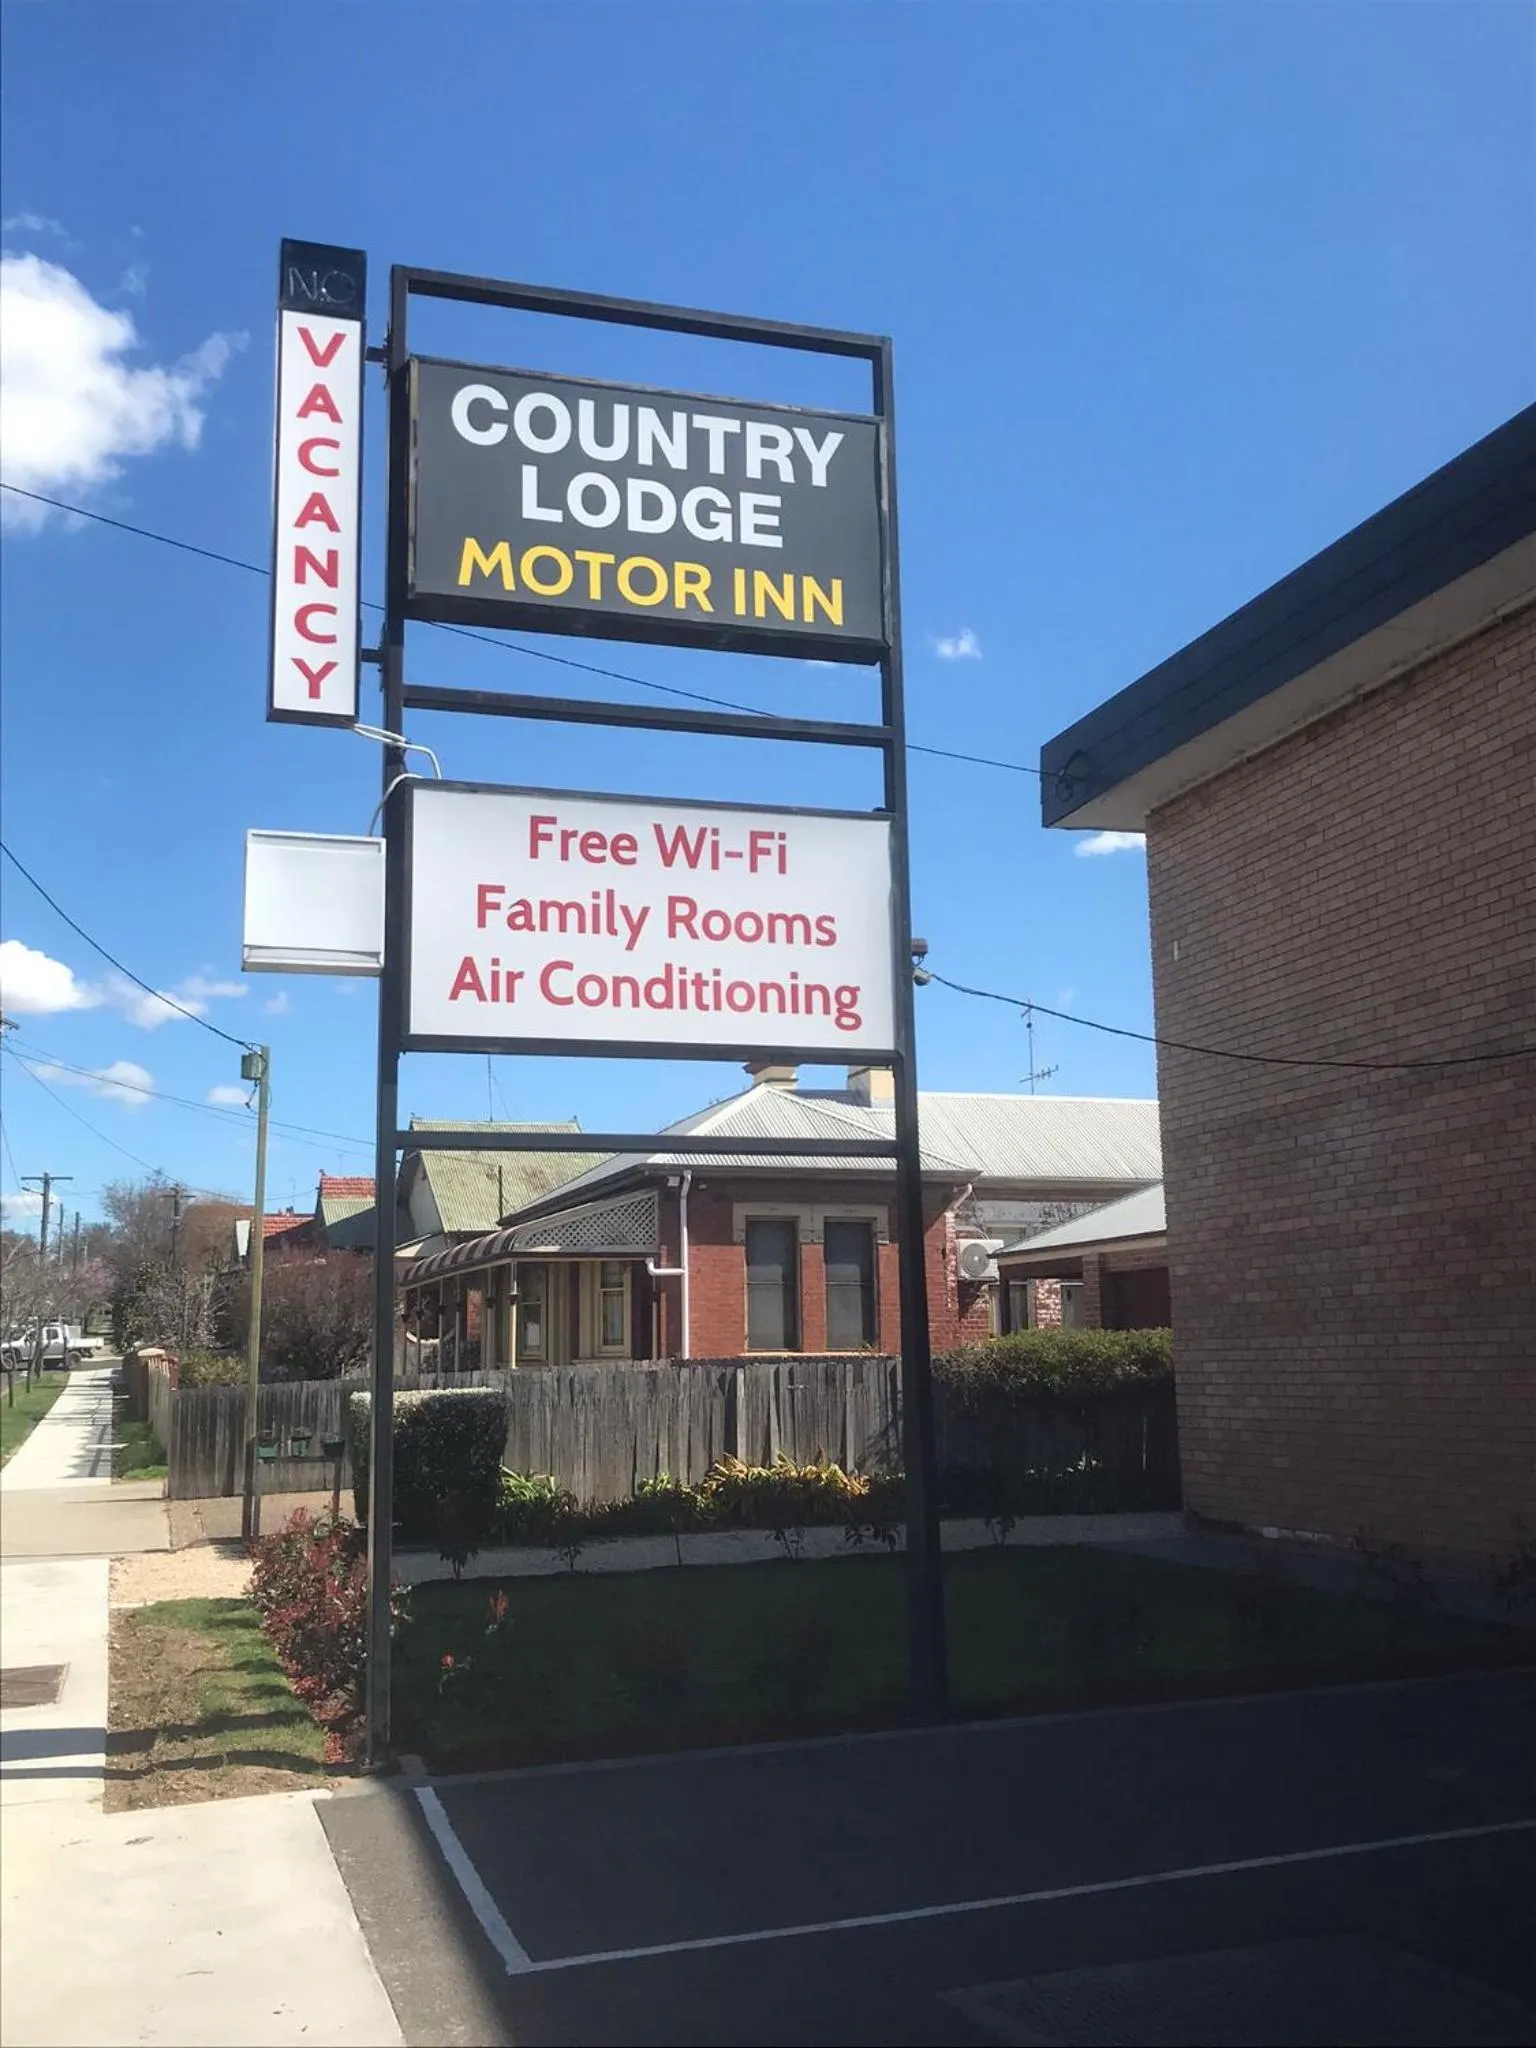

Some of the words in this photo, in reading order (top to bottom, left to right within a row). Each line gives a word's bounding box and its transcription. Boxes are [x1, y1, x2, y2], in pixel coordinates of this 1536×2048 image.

[288, 266, 357, 303] NO
[451, 383, 845, 487] COUNTRY
[290, 326, 347, 700] VACANCY
[522, 464, 784, 549] LODGE
[458, 536, 714, 612] MOTOR
[734, 567, 844, 626] INN
[528, 815, 638, 867] Free
[653, 822, 788, 875] Wi-Fi
[476, 884, 651, 951] Family
[667, 894, 838, 948] Rooms
[449, 956, 524, 1003] Air
[539, 959, 863, 1032] Conditioning
